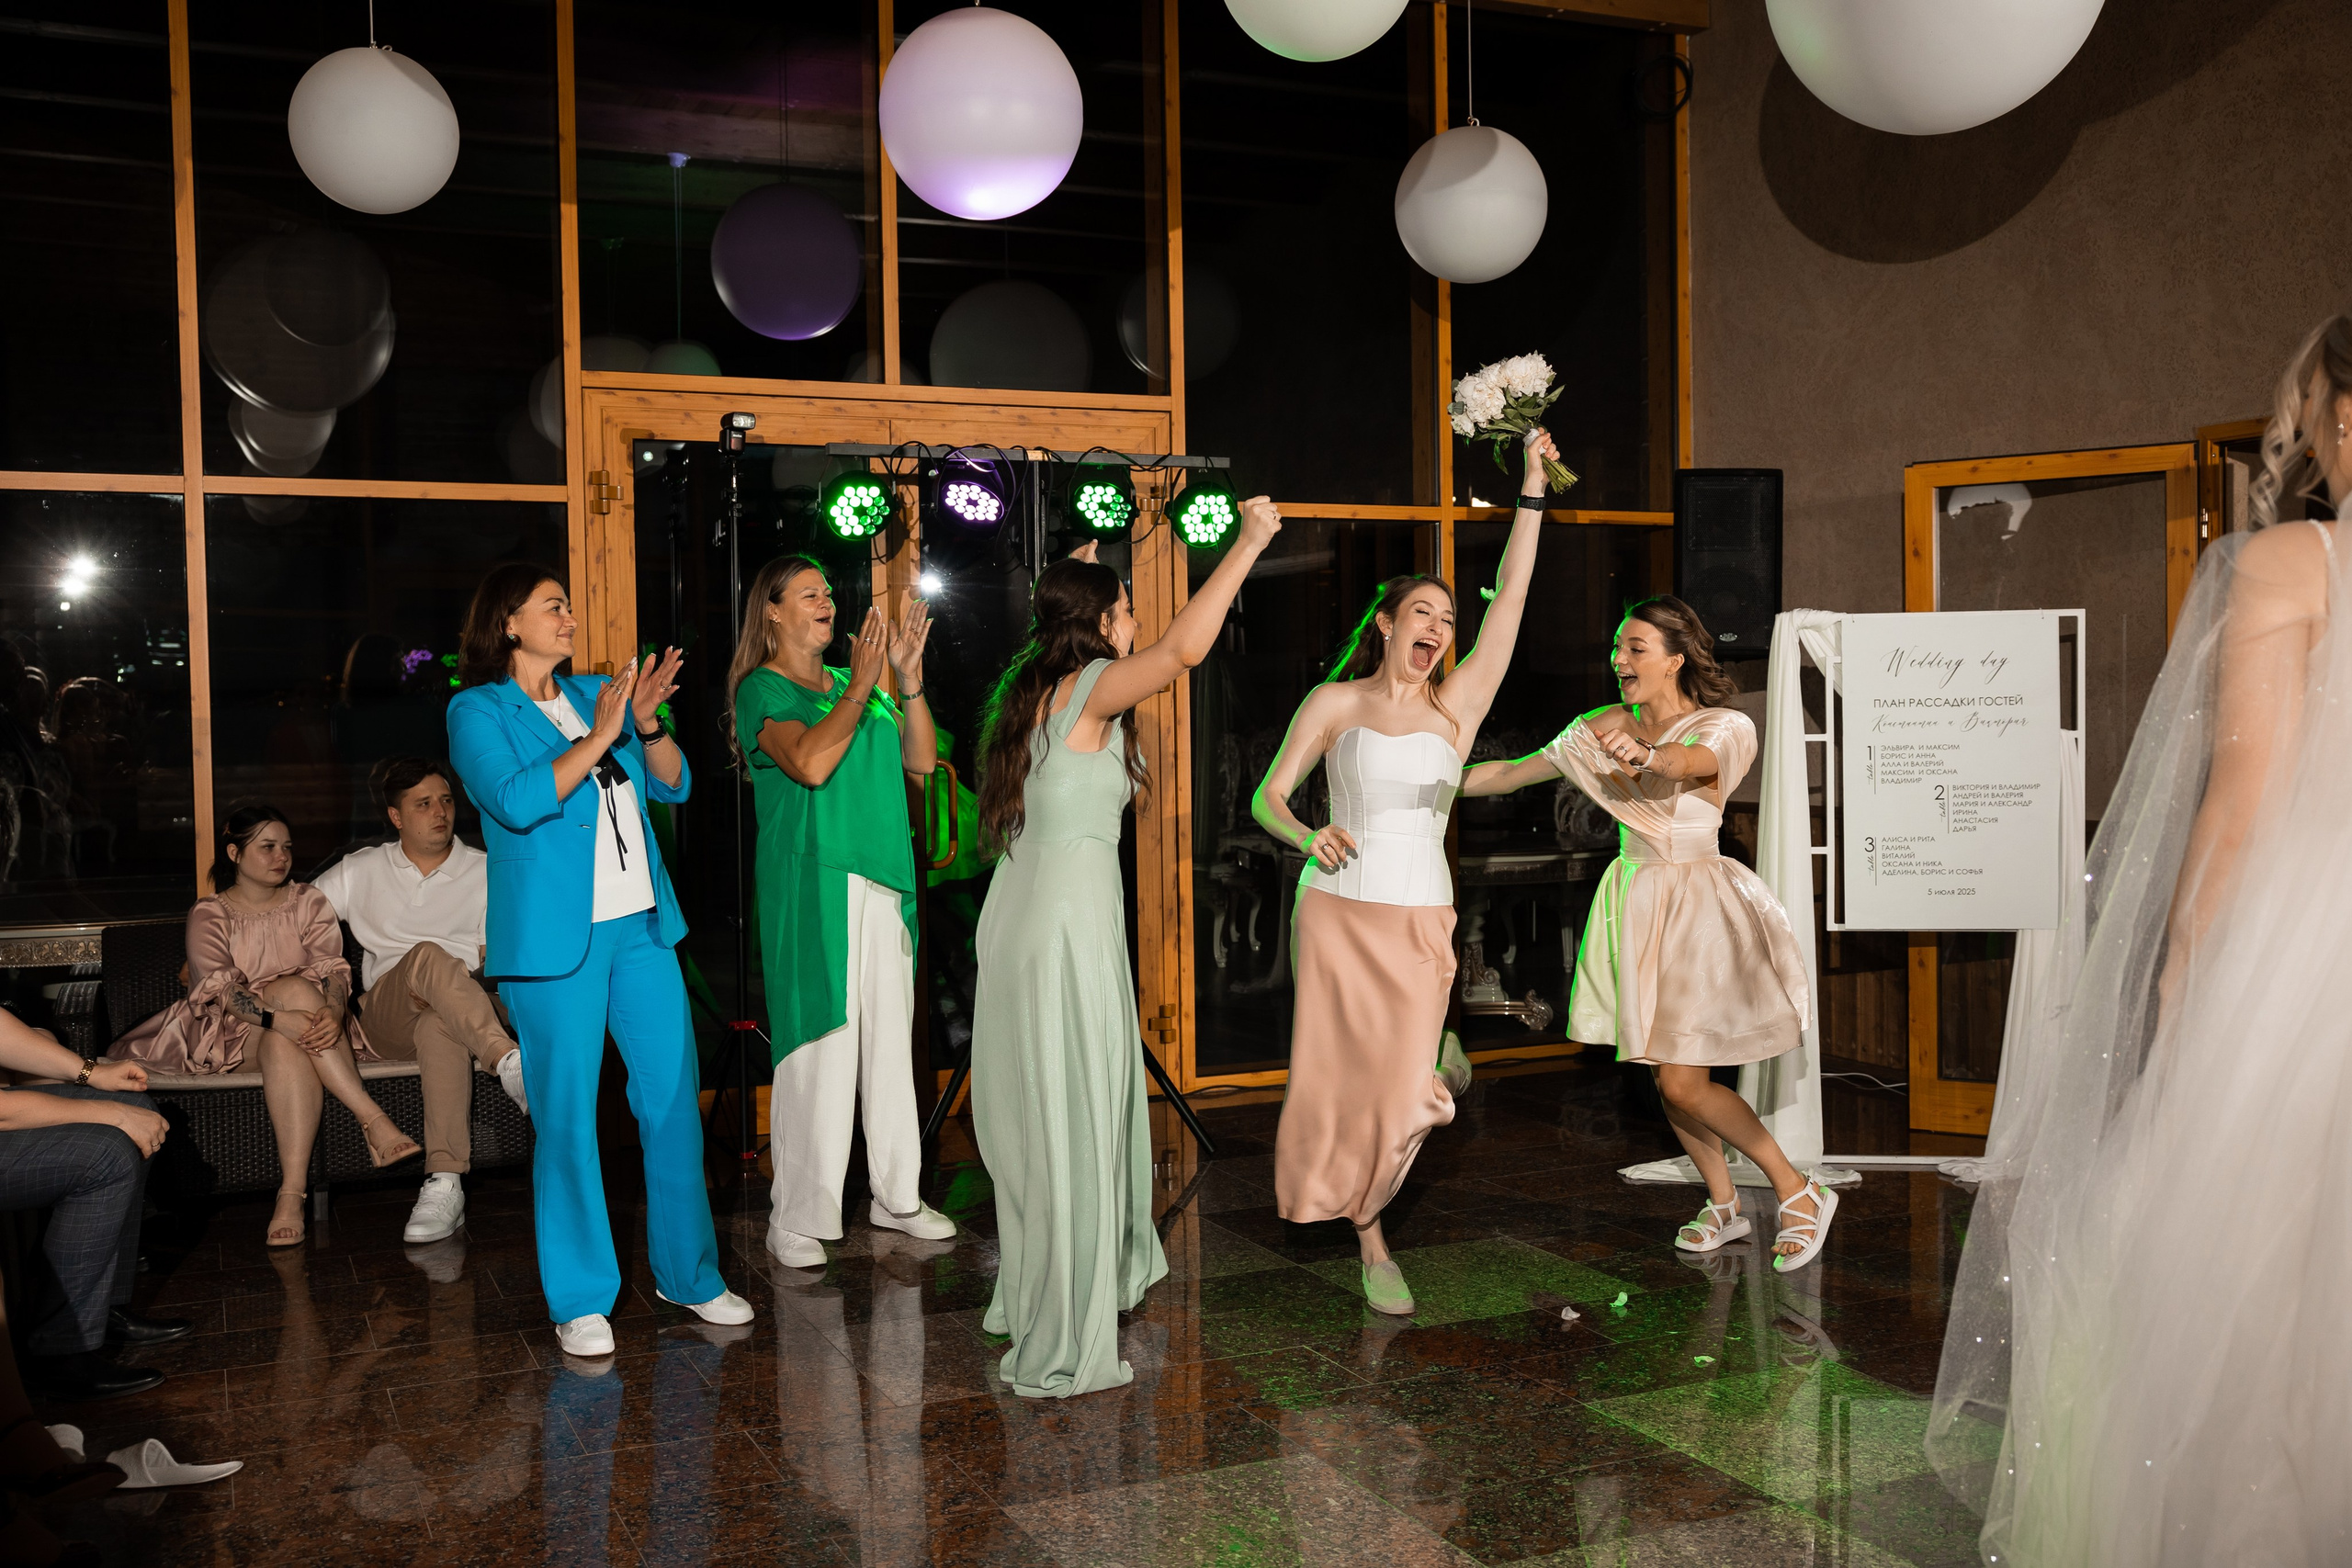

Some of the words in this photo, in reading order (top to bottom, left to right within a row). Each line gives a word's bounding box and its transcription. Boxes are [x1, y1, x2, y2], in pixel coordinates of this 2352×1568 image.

[1880, 645, 1967, 690] Wedding
[1979, 649, 2011, 685] day
[1874, 699, 1905, 707] ПЛАН
[1909, 697, 1974, 707] РАССАДКИ
[1979, 694, 2023, 705] ГОСТЕЙ
[1867, 746, 1871, 761] 1
[1934, 784, 1945, 800] 2
[1864, 837, 1875, 852] 3
